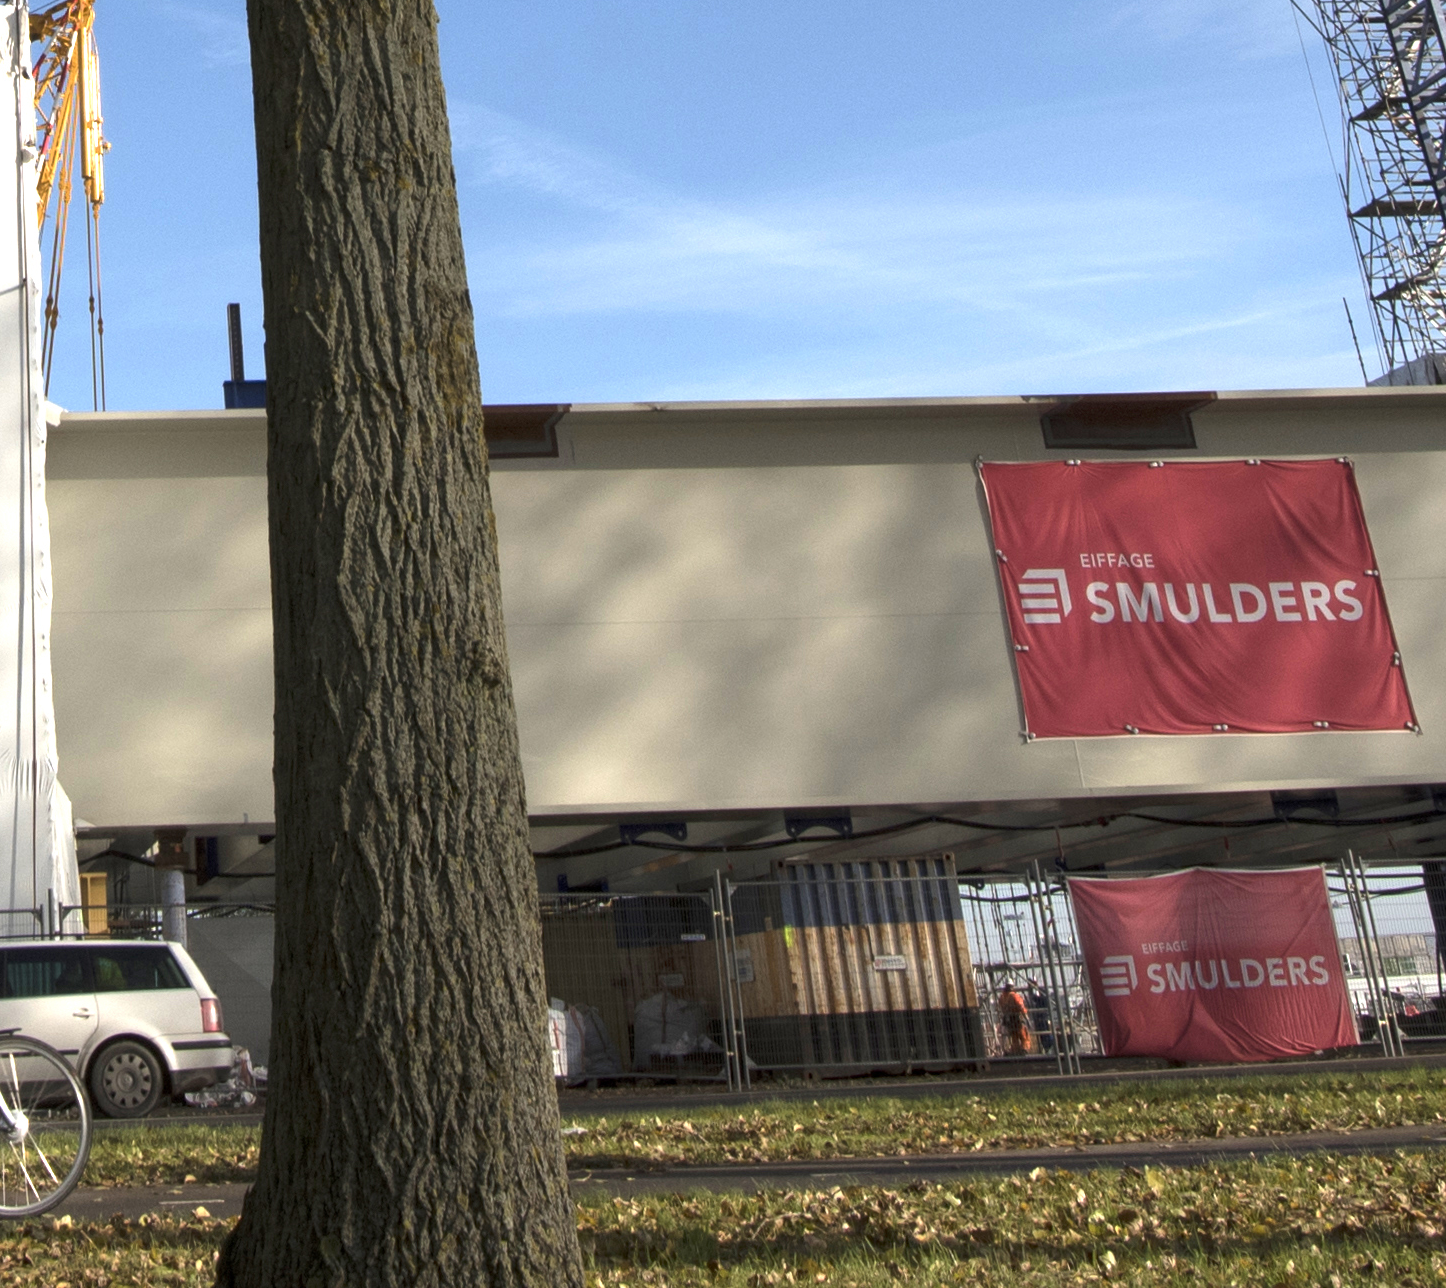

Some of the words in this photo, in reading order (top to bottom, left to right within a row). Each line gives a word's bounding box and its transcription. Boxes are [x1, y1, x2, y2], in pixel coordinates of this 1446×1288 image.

[1079, 553, 1154, 568] EIFFAGE
[1086, 579, 1363, 622] SMULDERS
[1141, 941, 1189, 955] EIFFAGE
[1147, 956, 1329, 993] SMULDERS
